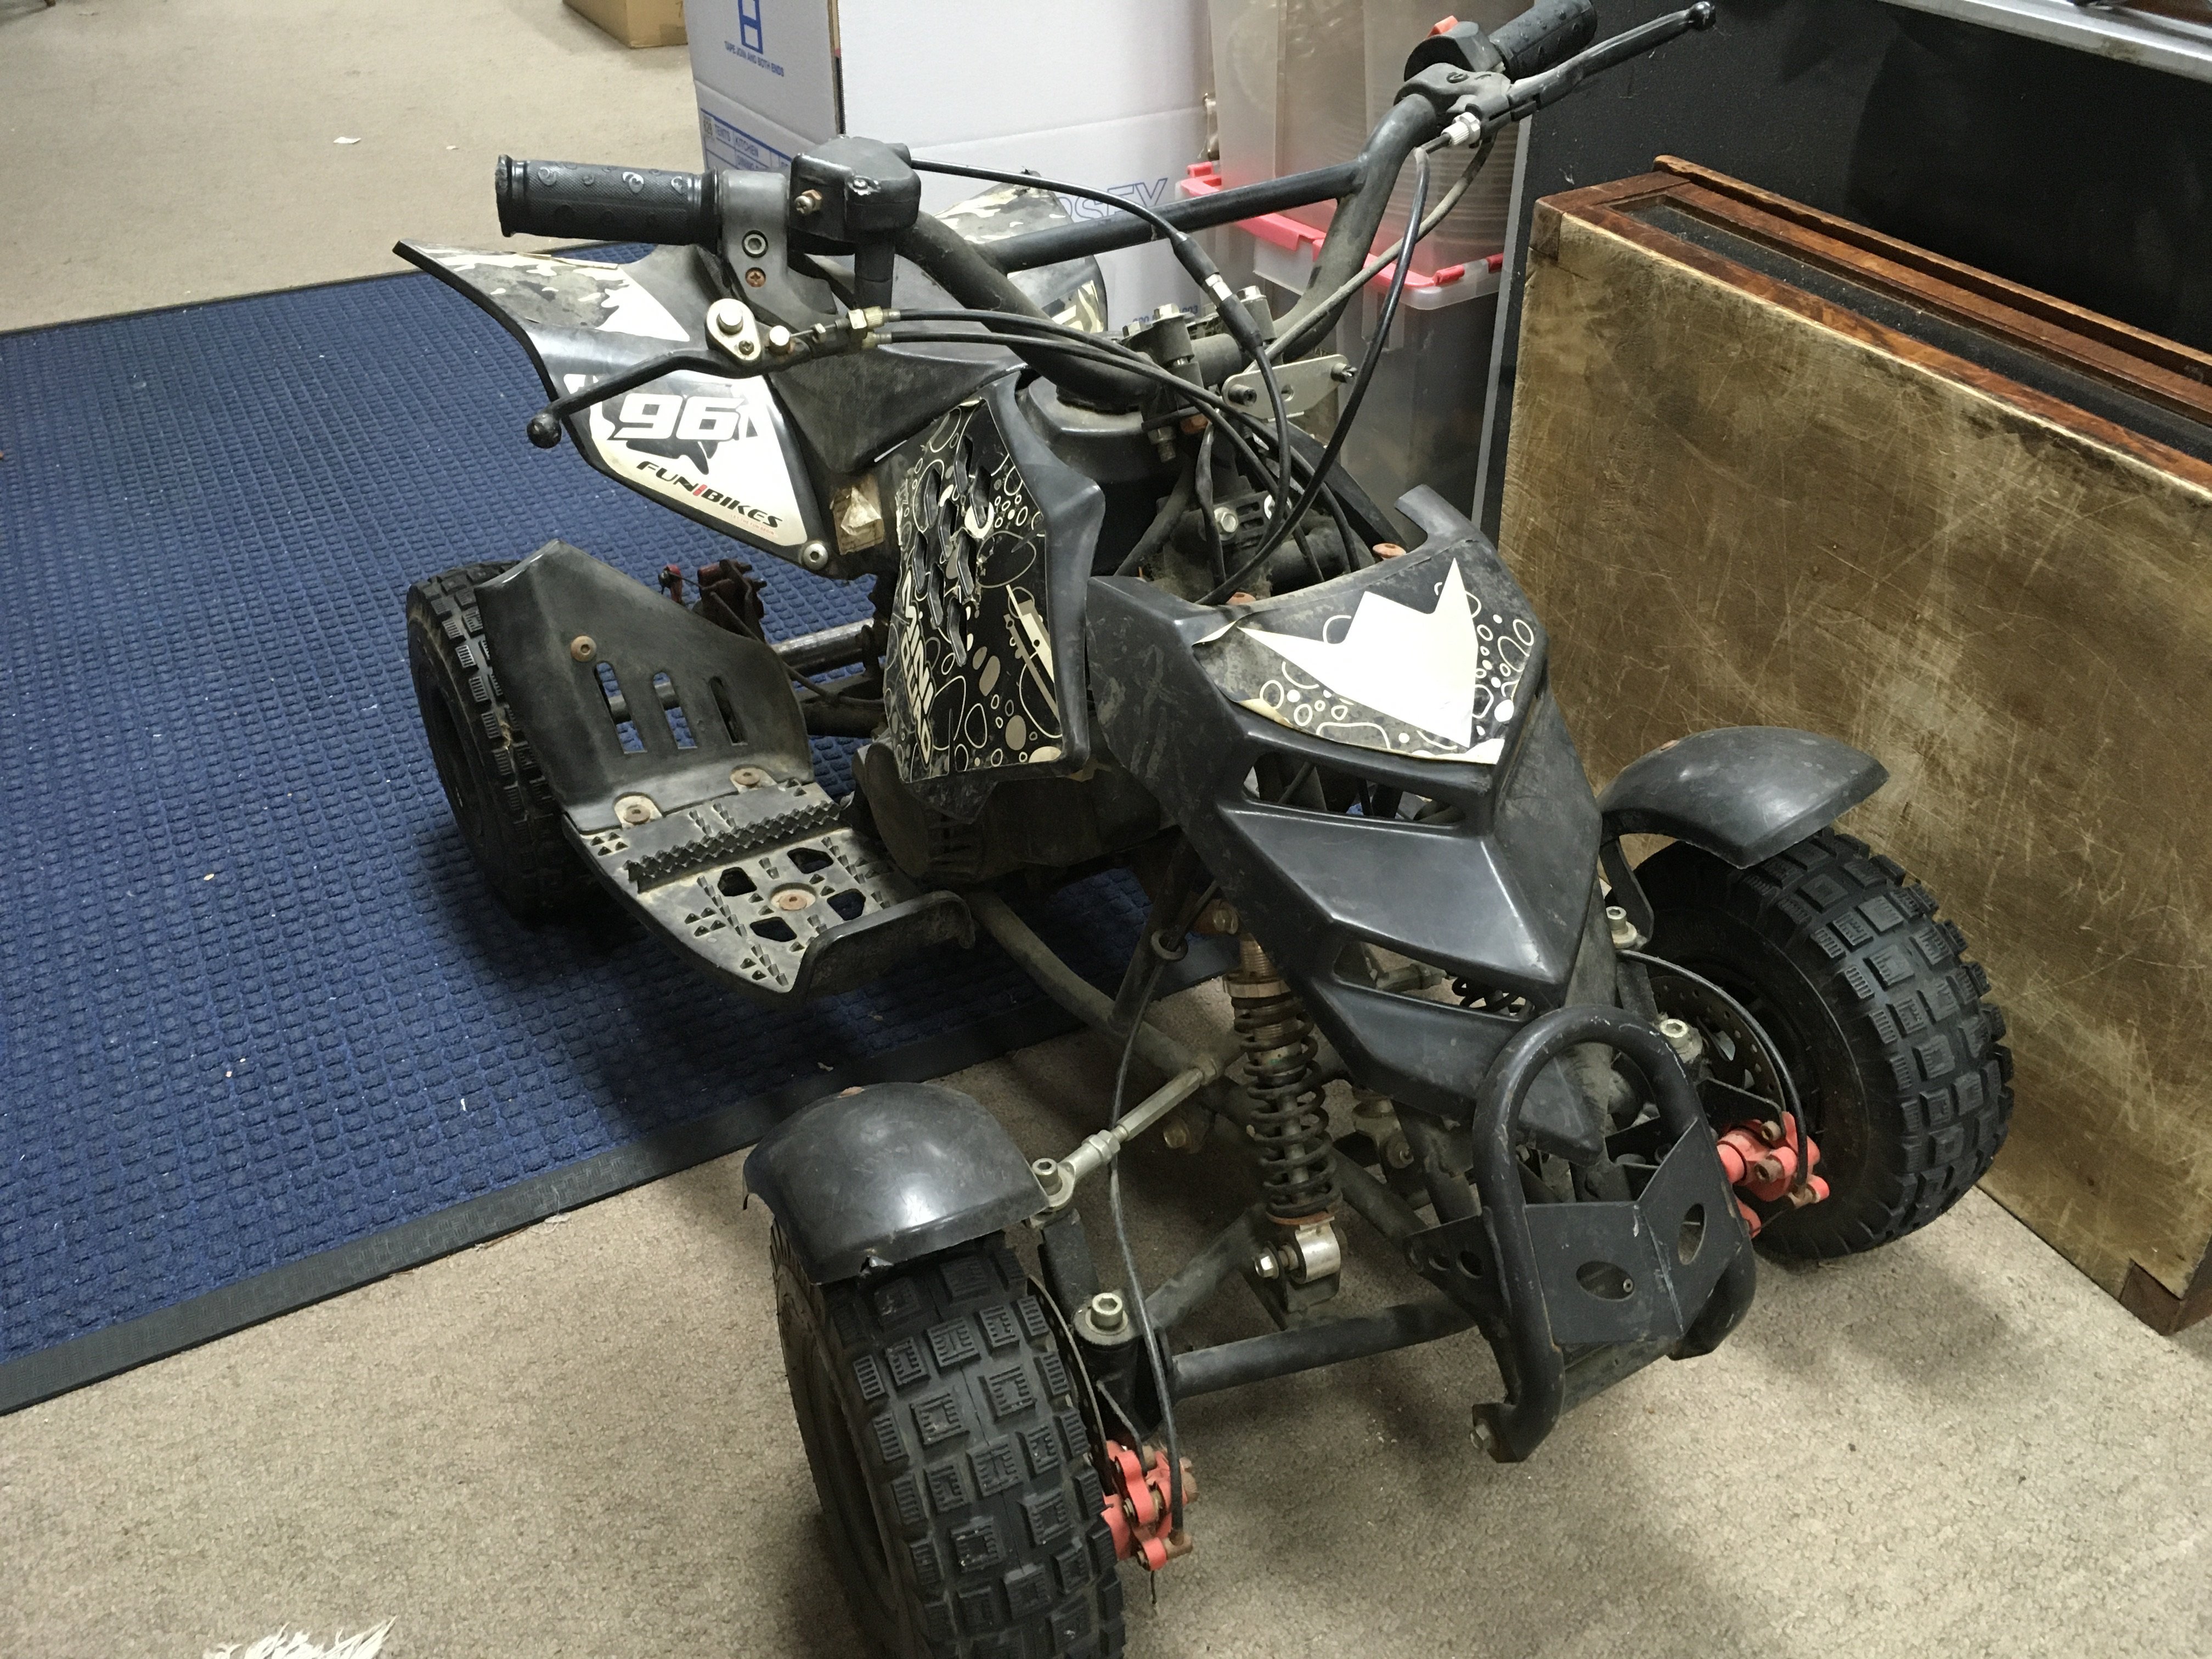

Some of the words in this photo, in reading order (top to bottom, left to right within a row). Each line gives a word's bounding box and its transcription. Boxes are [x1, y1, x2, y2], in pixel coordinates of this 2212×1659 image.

[735, 137, 759, 157] KITCHEN
[613, 393, 746, 440] 96
[901, 569, 933, 714] MINI
[901, 631, 931, 764] QUAD
